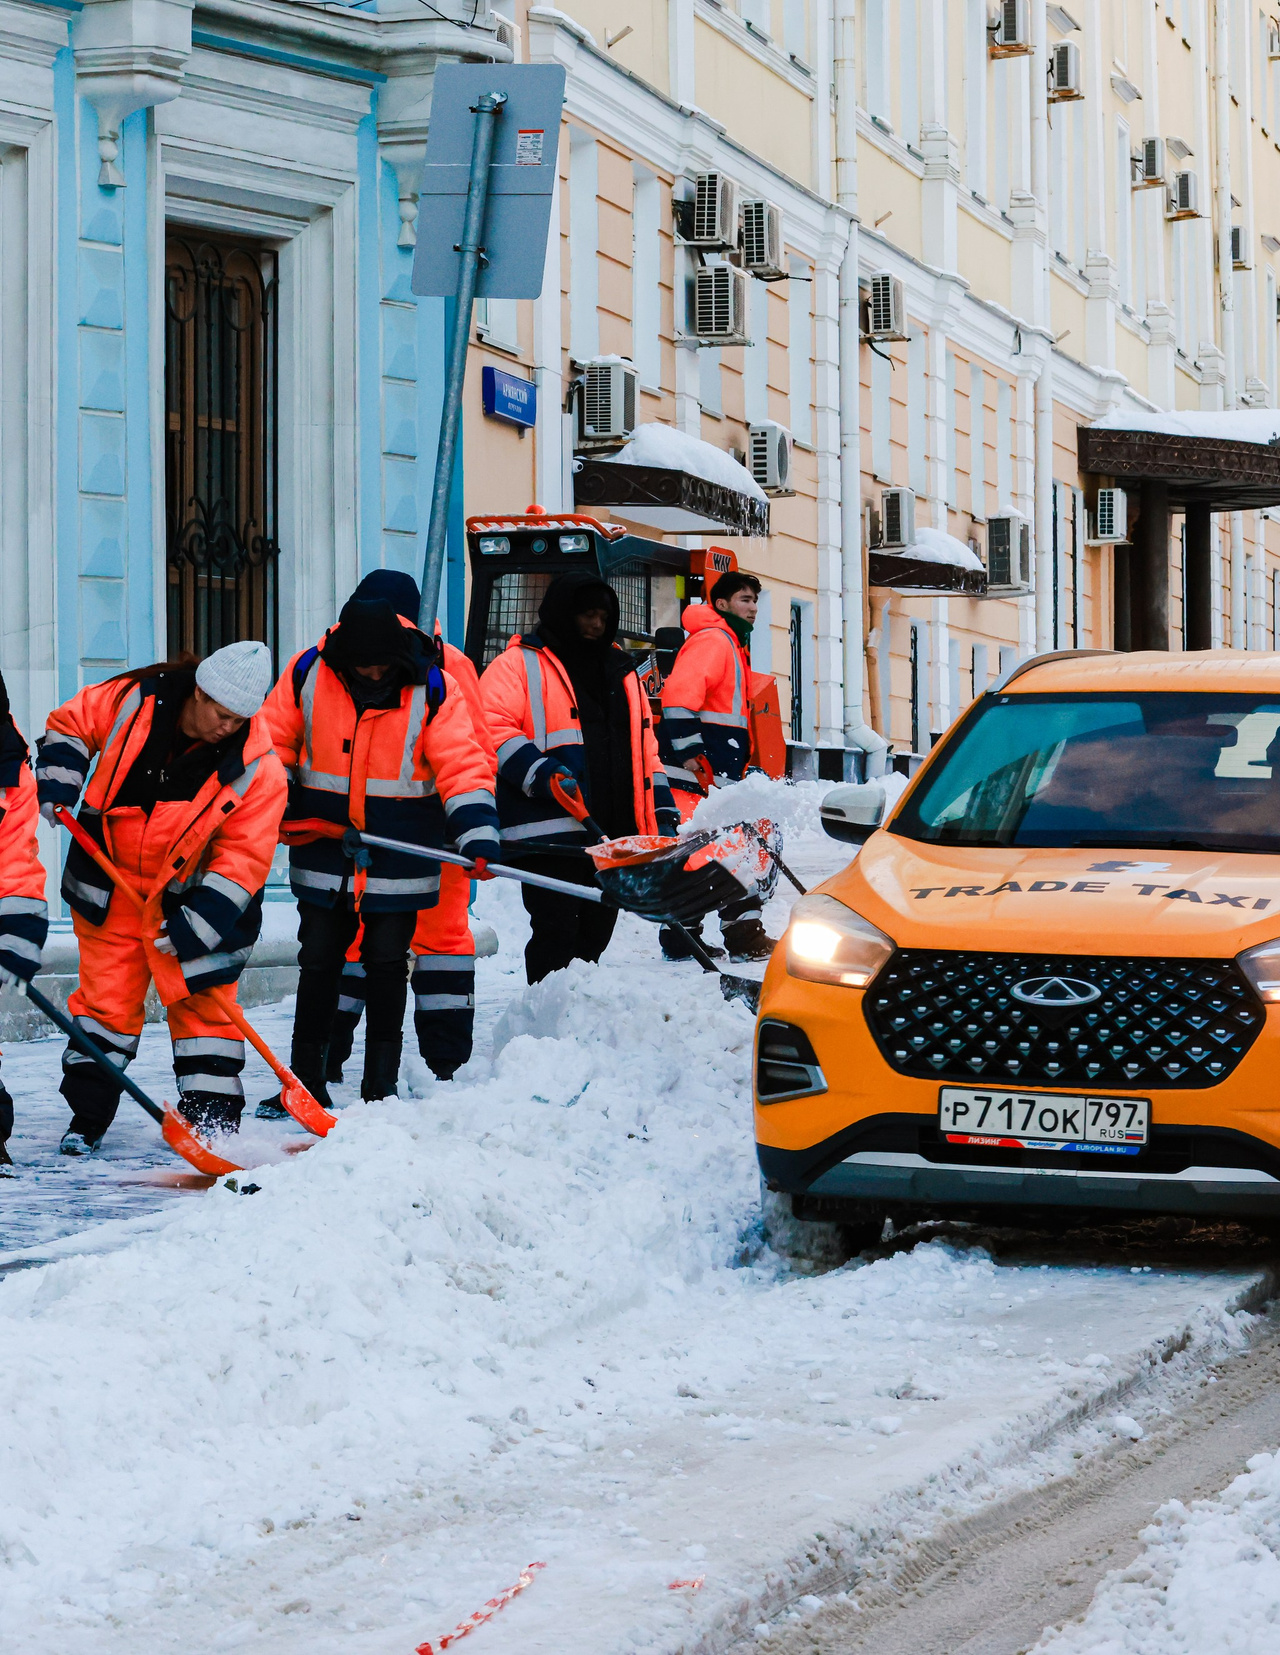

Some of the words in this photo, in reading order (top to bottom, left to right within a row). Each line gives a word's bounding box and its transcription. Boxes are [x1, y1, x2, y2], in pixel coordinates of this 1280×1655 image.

[713, 552, 732, 573] WAY
[909, 880, 1111, 900] TRADE
[1132, 883, 1272, 911] TAXI
[1088, 1101, 1138, 1128] 797
[967, 1136, 1002, 1146] ЛИЗИНГ
[1100, 1129, 1124, 1139] RUS
